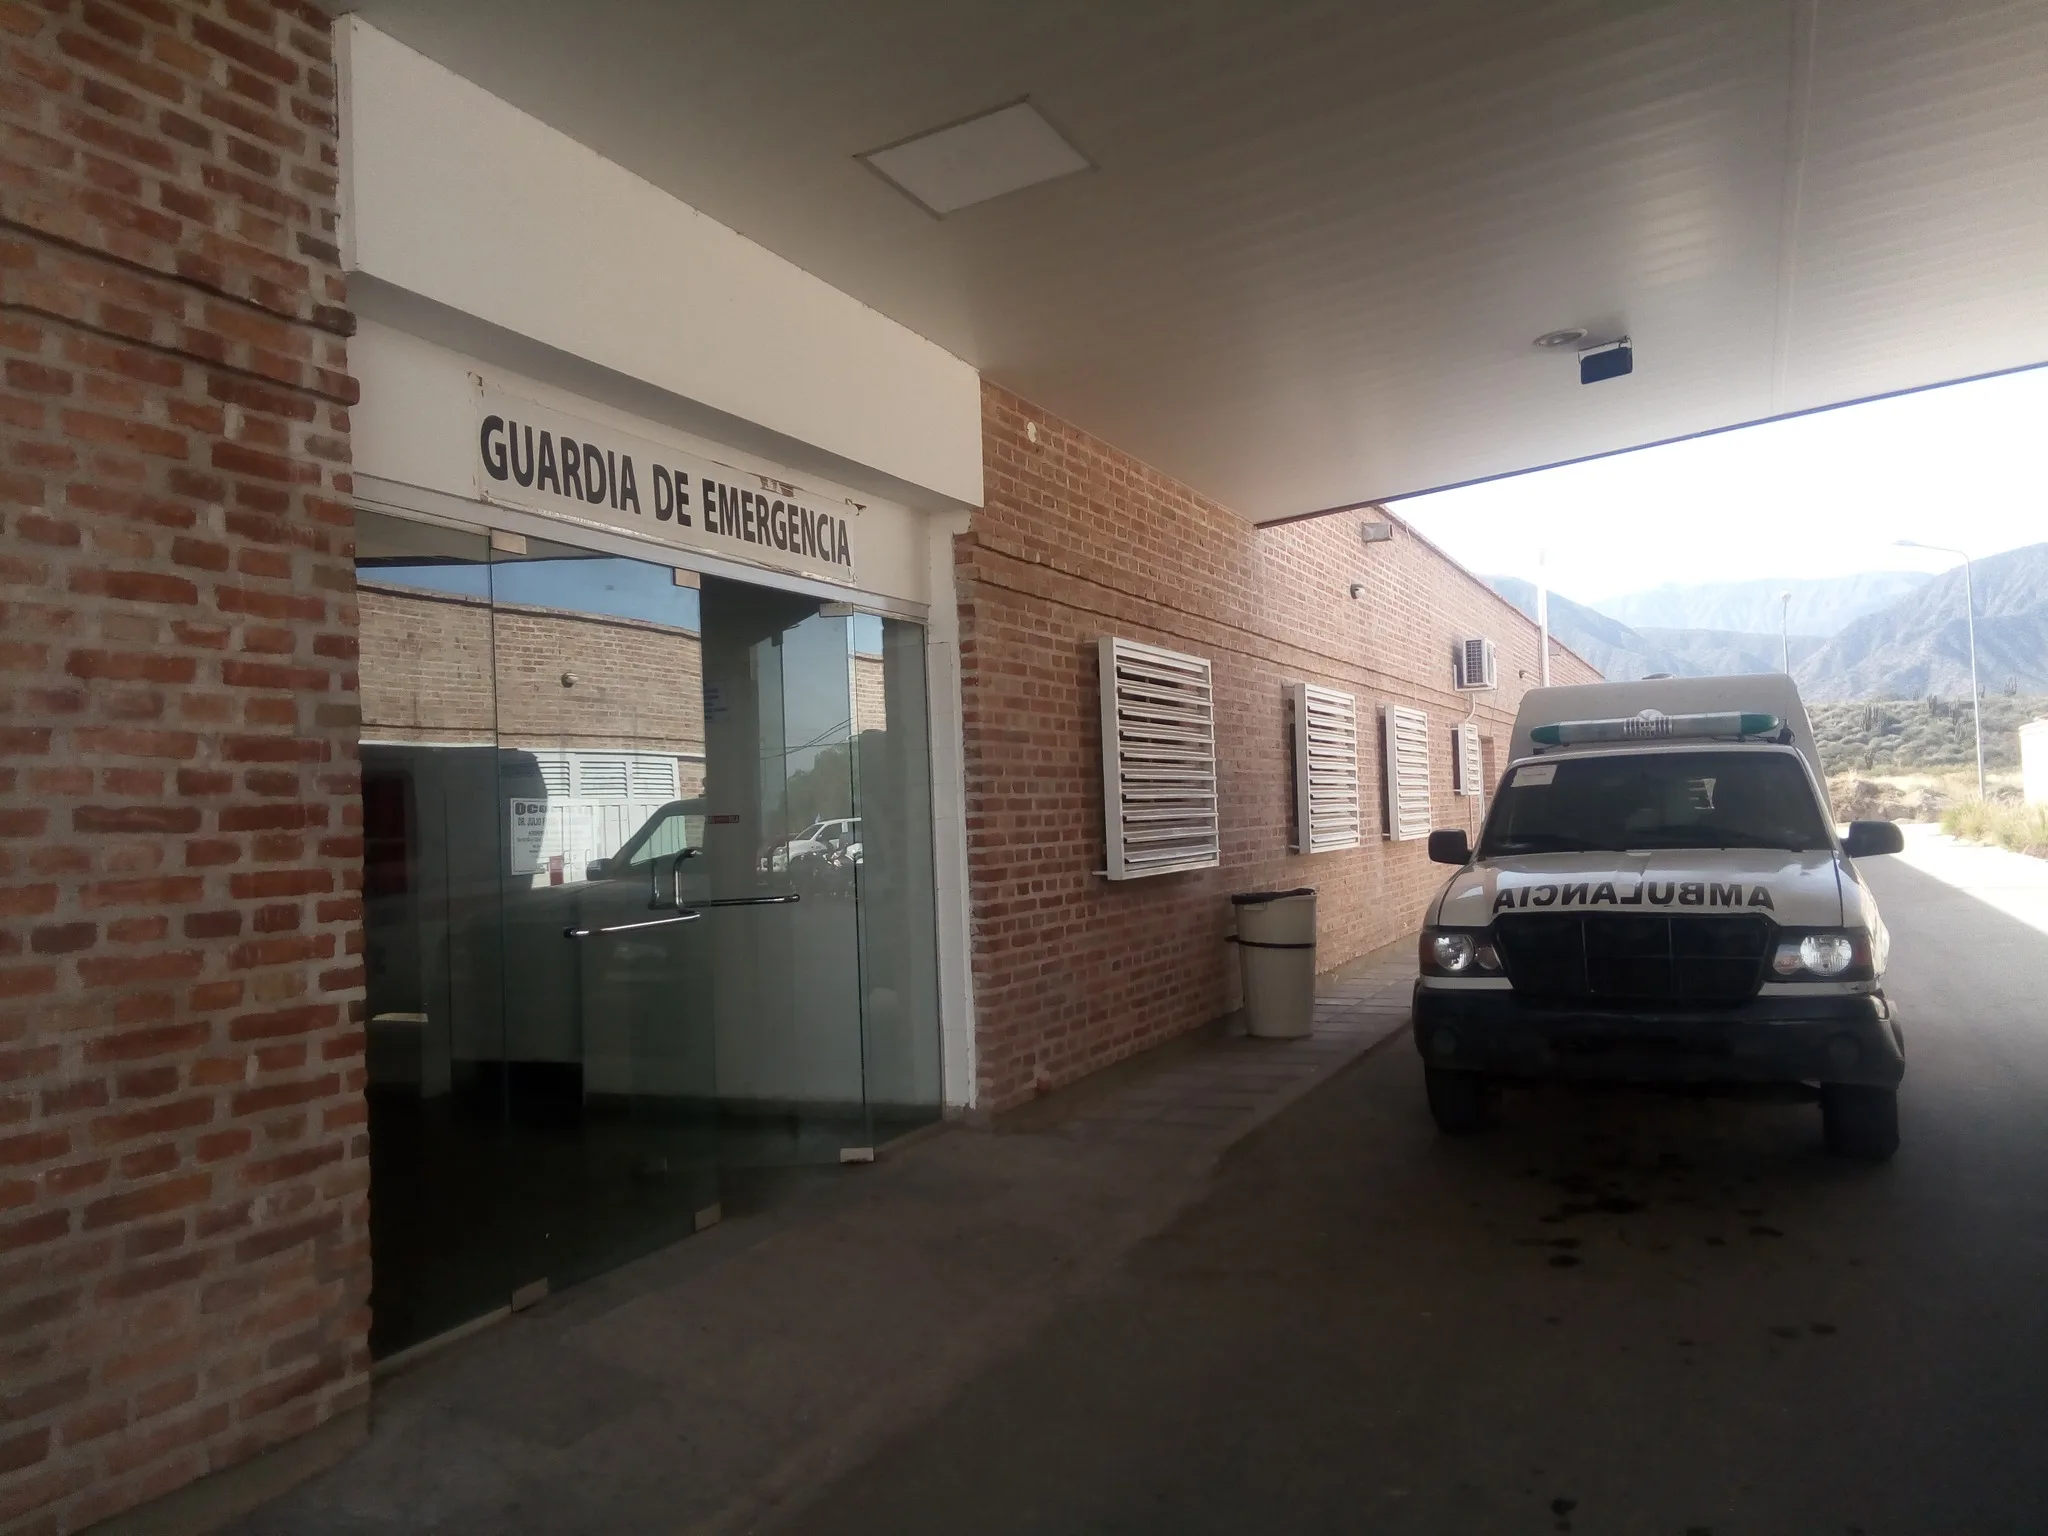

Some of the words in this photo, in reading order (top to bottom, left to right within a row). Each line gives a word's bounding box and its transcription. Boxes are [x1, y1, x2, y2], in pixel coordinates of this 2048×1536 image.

[480, 415, 641, 515] GUARDIA
[652, 463, 692, 527] DE
[702, 478, 851, 567] EMERGENCIA
